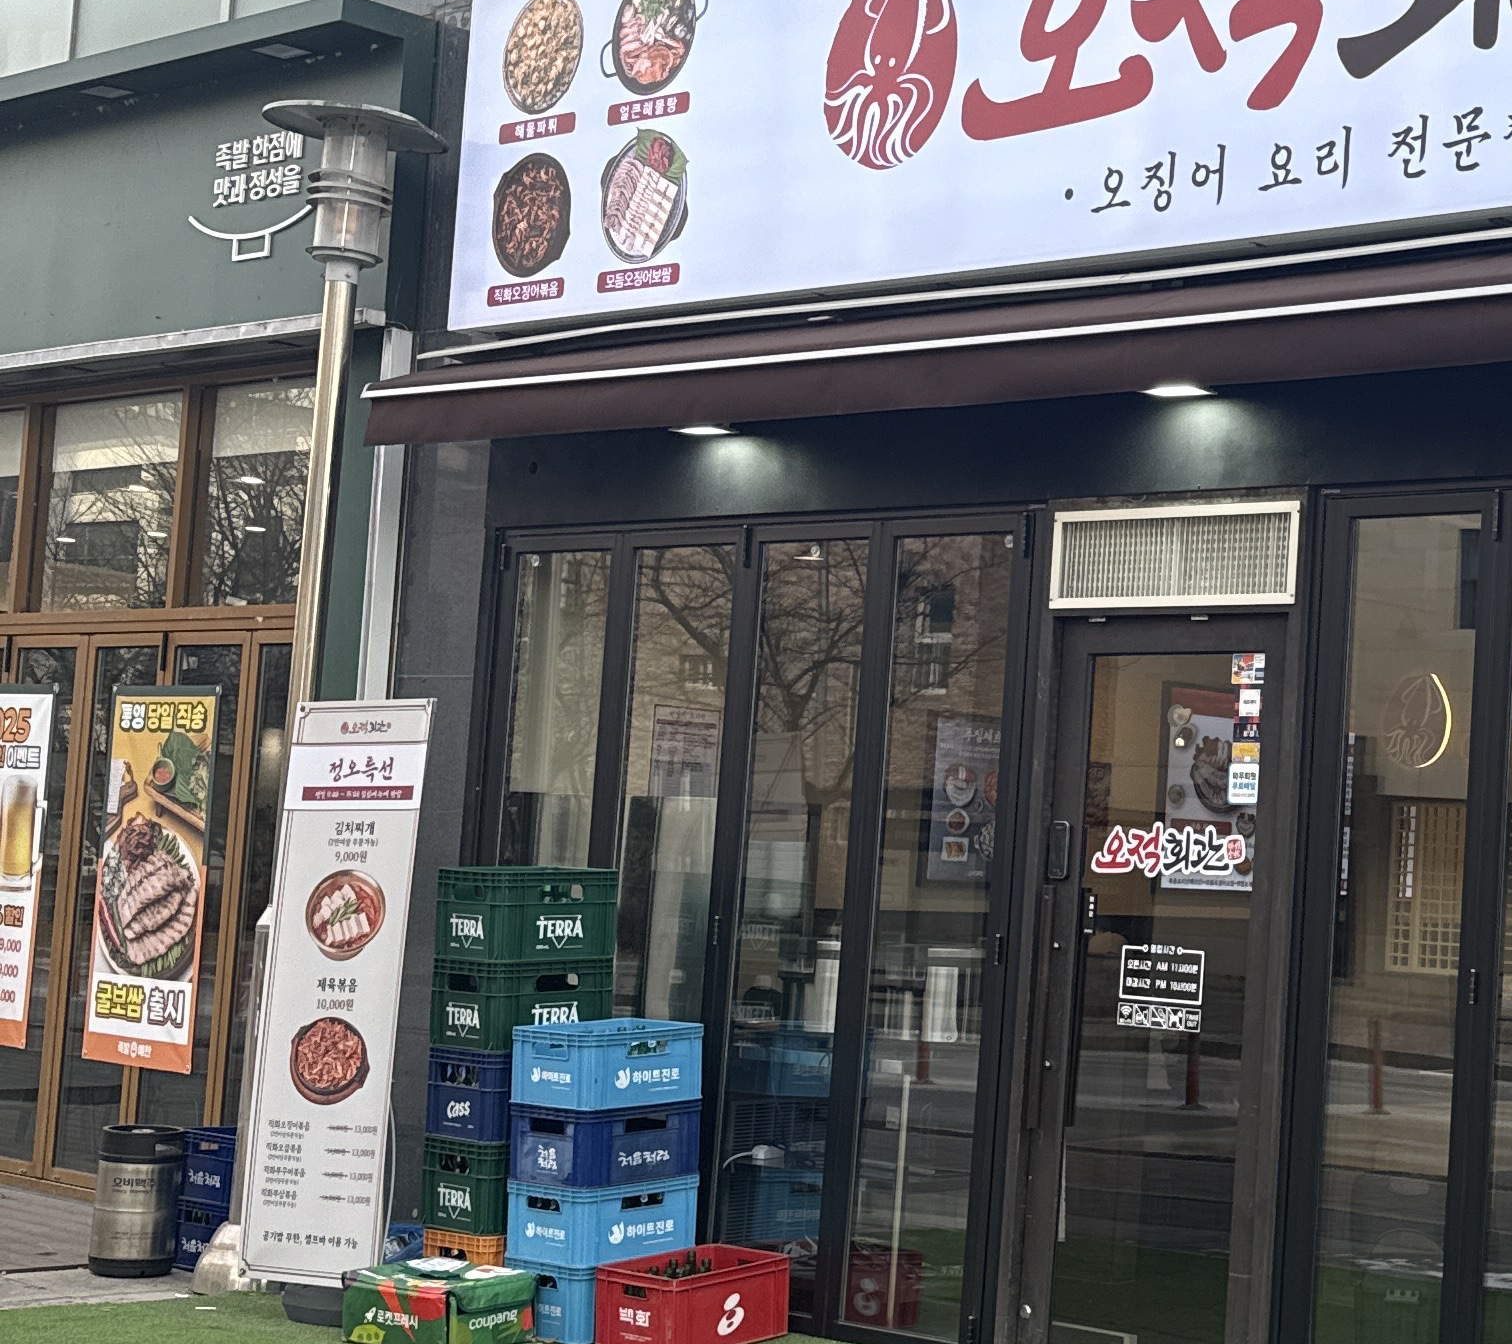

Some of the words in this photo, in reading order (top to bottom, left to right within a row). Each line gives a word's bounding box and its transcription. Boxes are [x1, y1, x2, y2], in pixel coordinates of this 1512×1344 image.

[216, 138, 251, 171] 족발
[252, 131, 304, 165] 한점에
[1090, 144, 1230, 216] 오징어
[1259, 124, 1350, 194] 요리
[213, 174, 248, 207] 맛과
[249, 164, 302, 200] 정성을
[606, 269, 673, 289] 모듬오징어보쌈
[494, 281, 559, 302] 직화오징어볶음
[120, 702, 146, 732] 통영
[147, 702, 176, 733] 당일
[176, 700, 208, 733] 직송
[7, 745, 41, 769] 이벤트
[329, 756, 395, 782] 정오특선
[335, 821, 376, 836] 김치찌개
[1094, 824, 1231, 876] 오적회관
[4, 905, 24, 928] 할인
[450, 916, 484, 940] TERRA
[536, 916, 583, 939] TERRA
[1156, 961, 1168, 971] AM
[316, 978, 358, 994] 제육볶음
[1155, 979, 1167, 989] PM
[95, 980, 146, 1023] 굴보쌈
[147, 986, 186, 1029] 출시
[446, 1005, 480, 1029] TERRA
[532, 1005, 579, 1026] TERRA
[541, 1070, 571, 1084] 하이트진로
[632, 1067, 681, 1085] 하이트진로
[113, 1177, 157, 1188] 오비맥주
[438, 1186, 472, 1212] TERRA
[535, 1225, 566, 1241] 하이트진로
[627, 1219, 675, 1238] 하이트진로
[376, 1309, 419, 1330] 로켓프레시
[469, 1309, 518, 1330] coupang
